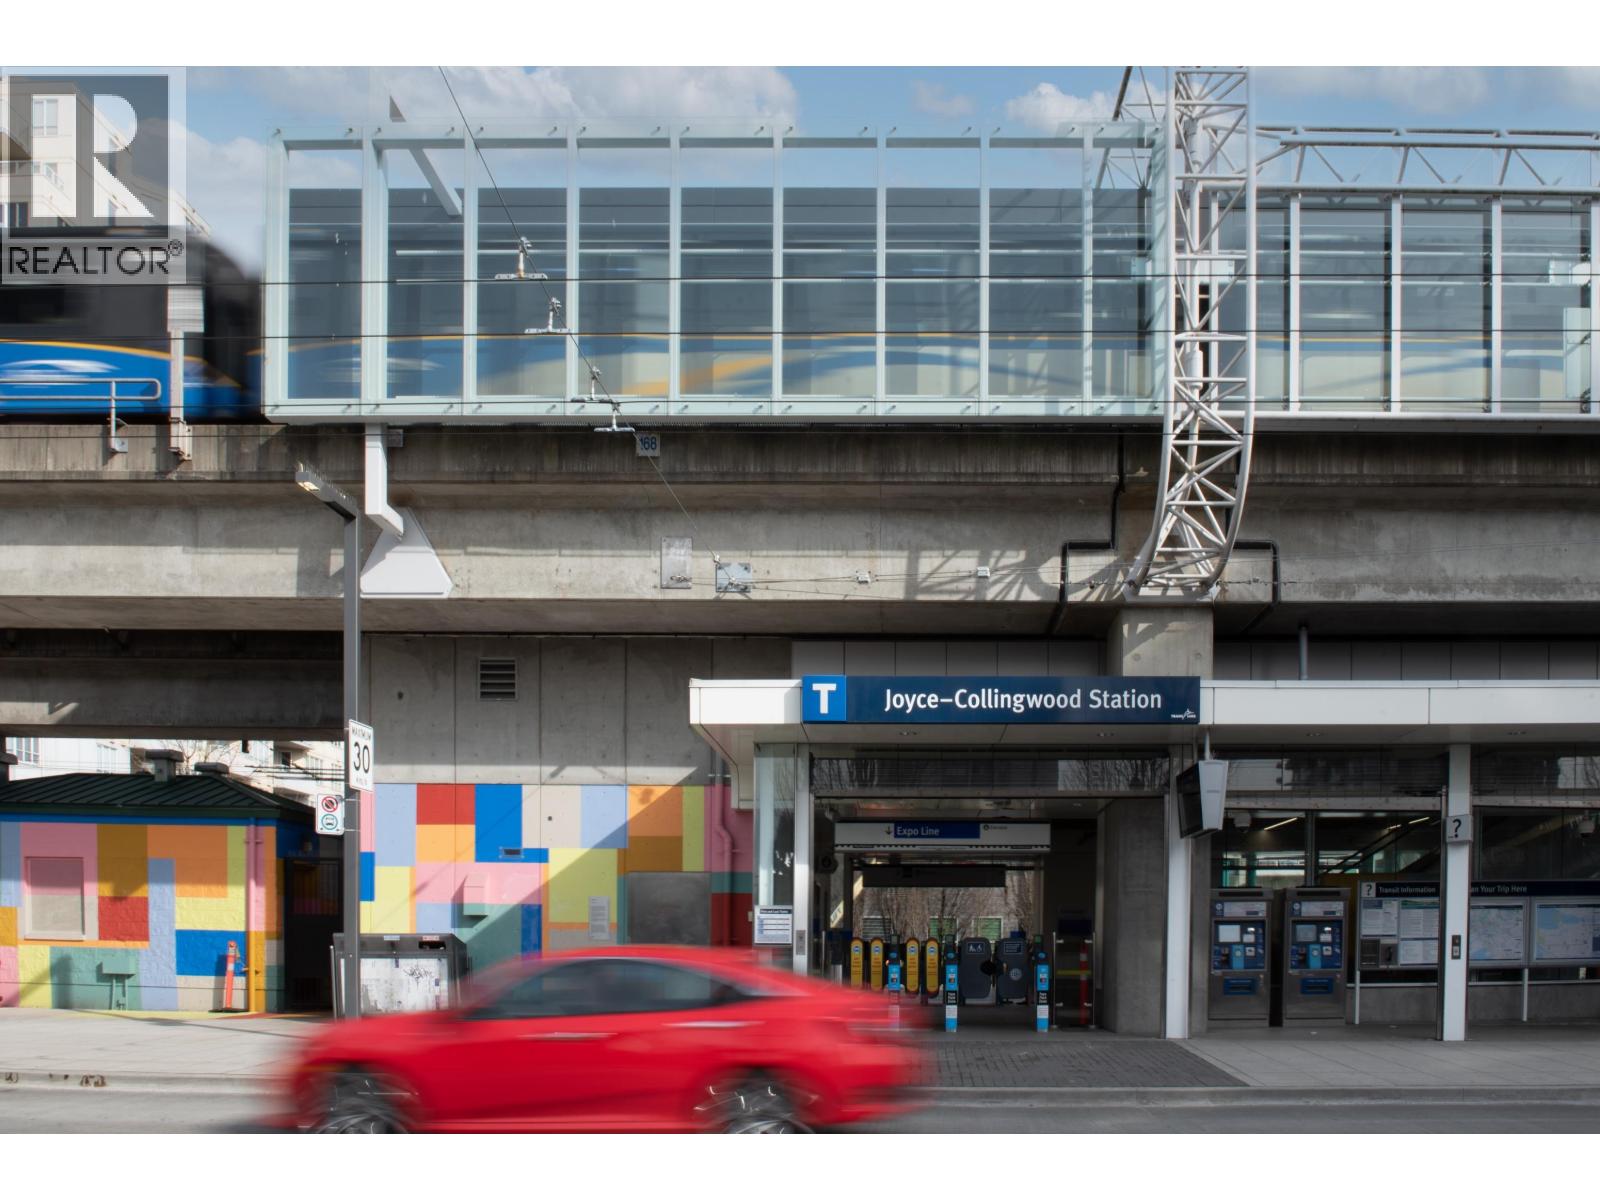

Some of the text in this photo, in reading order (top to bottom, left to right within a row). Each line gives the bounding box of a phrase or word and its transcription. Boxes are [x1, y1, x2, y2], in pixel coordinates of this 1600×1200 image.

[812, 683, 837, 714] T
[1089, 688, 1162, 709] Station
[353, 742, 370, 774] 30
[896, 826, 940, 837] Expo Line
[1480, 885, 1496, 893] Your
[1496, 885, 1510, 895] Trip
[1511, 885, 1528, 893] Here
